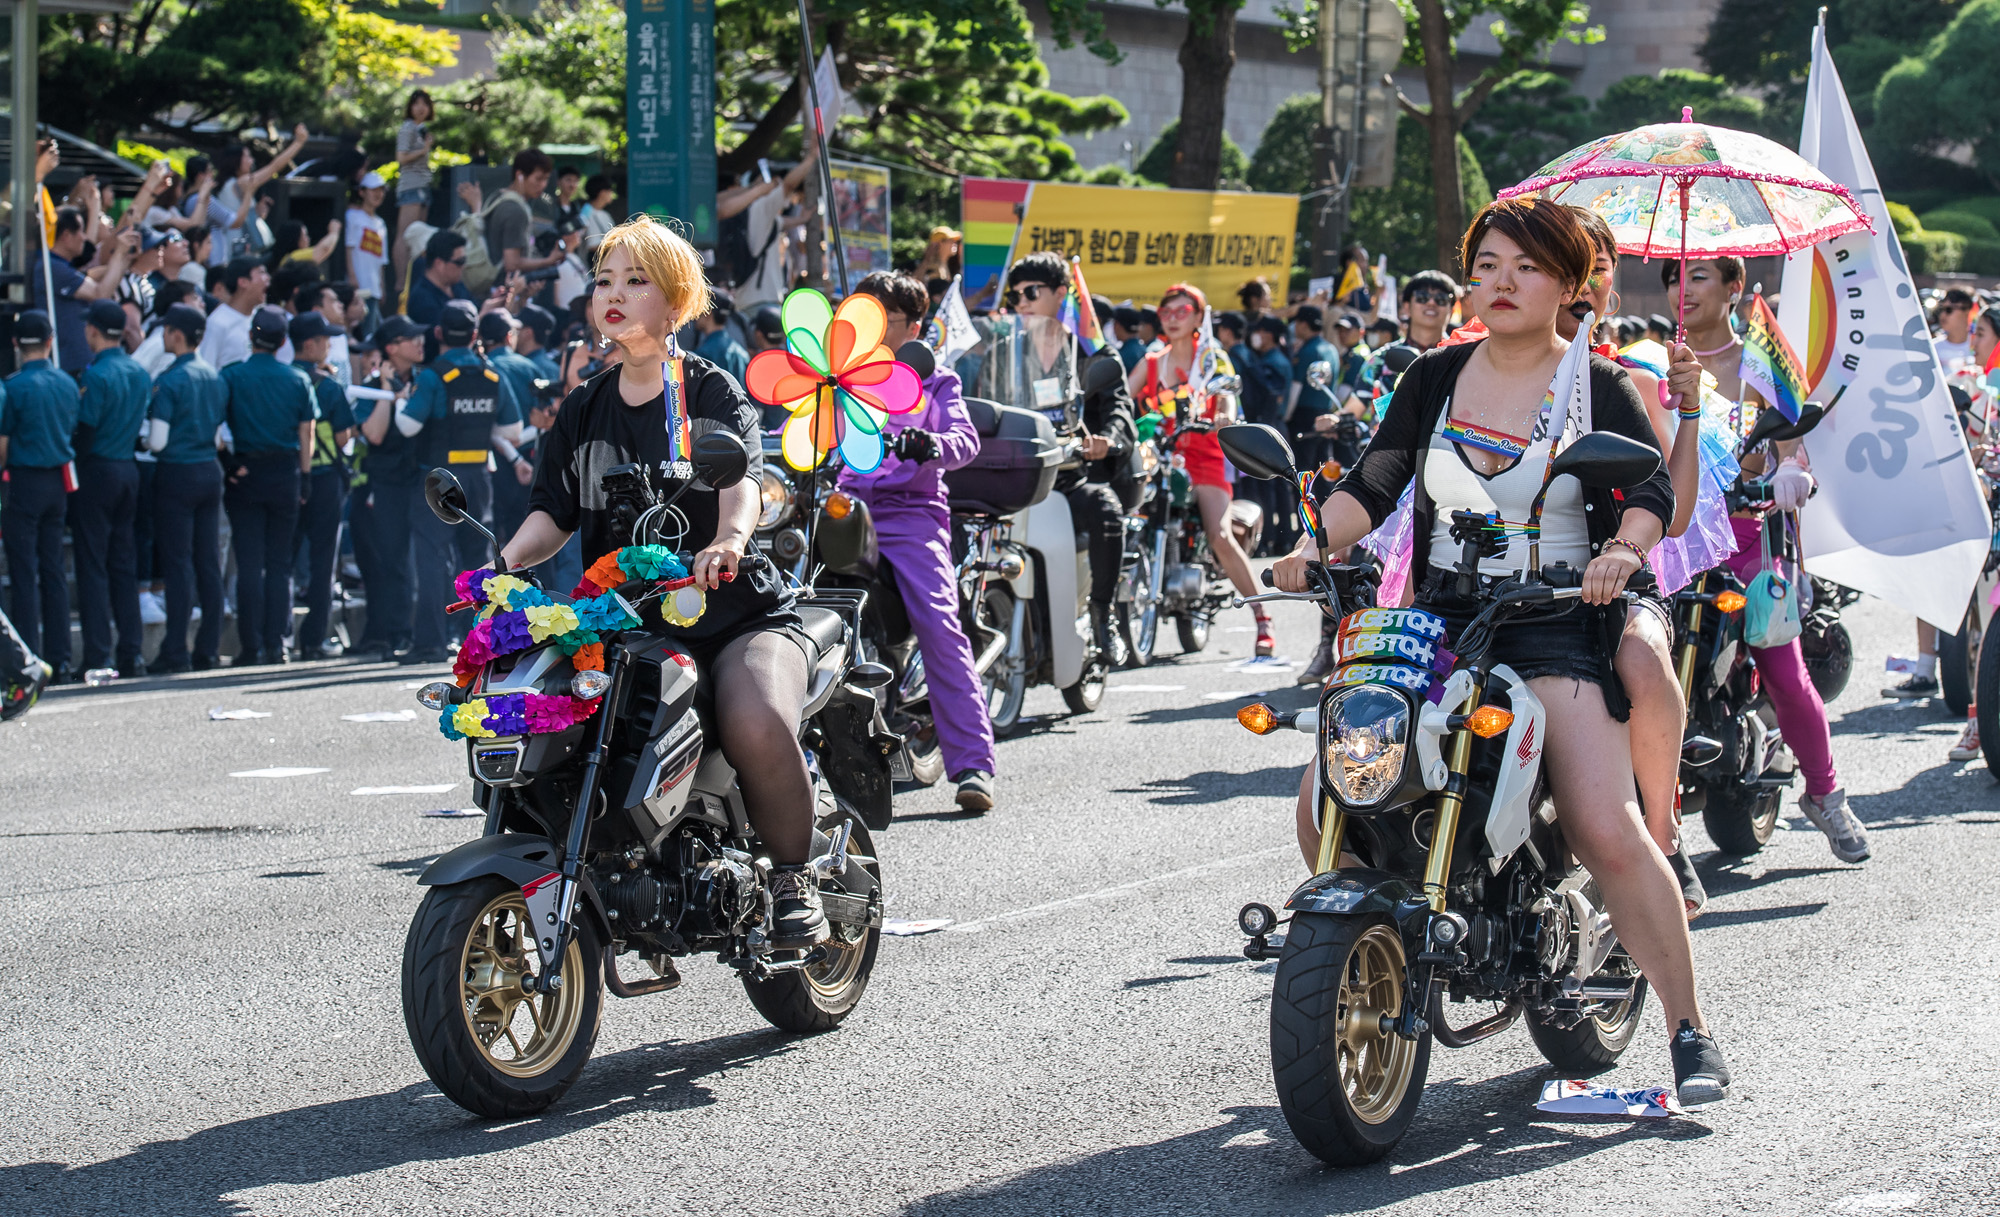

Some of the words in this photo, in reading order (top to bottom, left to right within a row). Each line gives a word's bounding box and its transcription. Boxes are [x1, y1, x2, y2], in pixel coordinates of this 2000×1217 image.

[637, 22, 659, 147] 을지로입구
[1090, 229, 1140, 265] 혐오를
[1145, 231, 1179, 266] 넘어
[1182, 233, 1214, 267] 함께
[1747, 322, 1801, 393] RIDERS
[1752, 312, 1803, 382] RAINBOW
[453, 398, 493, 414] POLICE
[669, 381, 680, 417] Rainbow
[673, 417, 683, 443] Riders
[1464, 429, 1499, 446] Rainbow
[1347, 610, 1446, 637] LGBTQ+
[1342, 633, 1435, 664] LGBTQ+
[1329, 665, 1431, 689] LGBTQ+
[1519, 748, 1541, 770] HONDA
